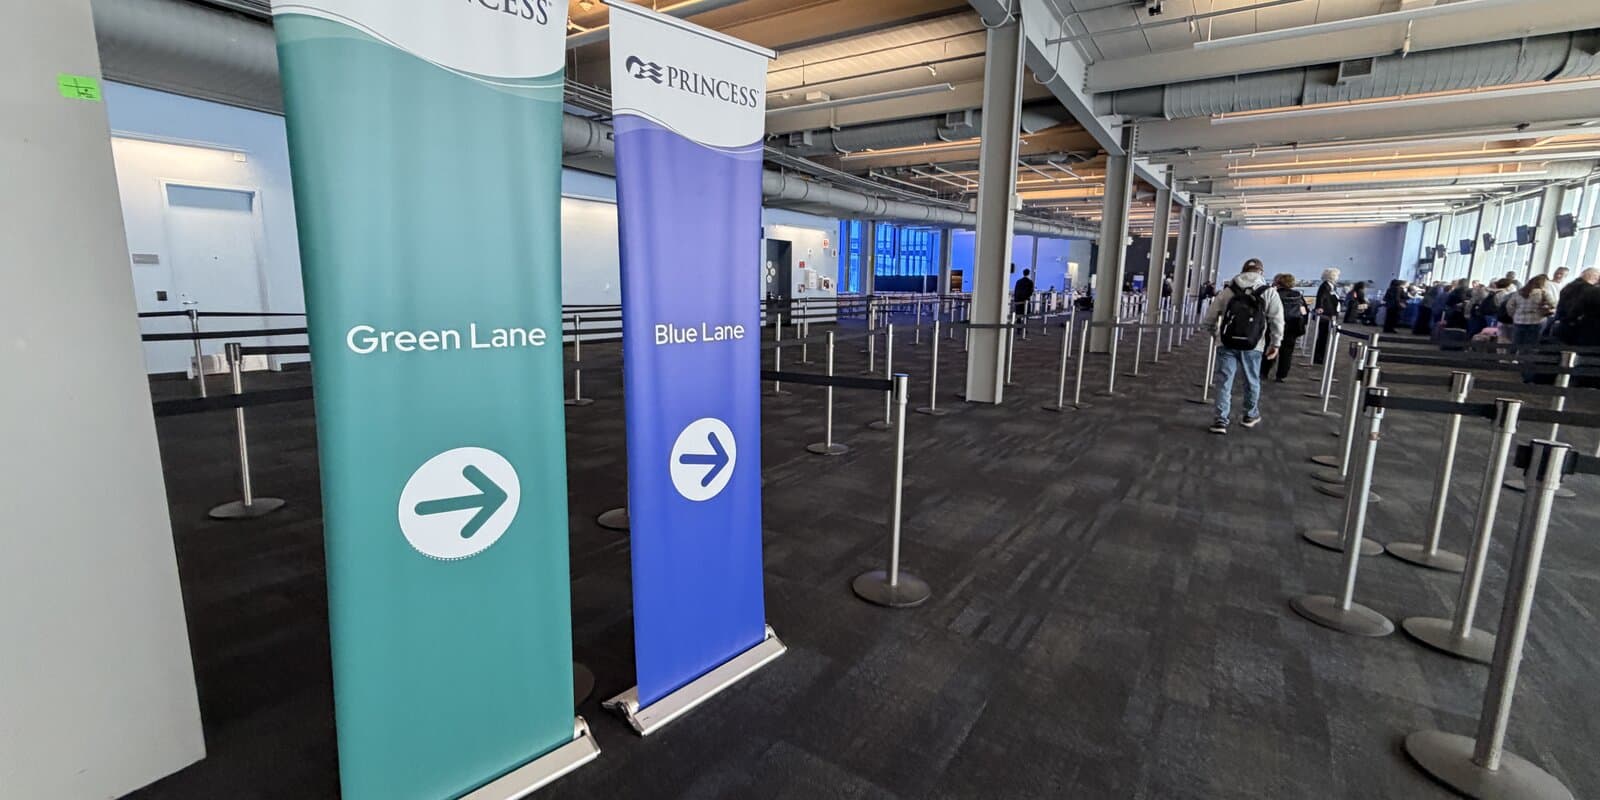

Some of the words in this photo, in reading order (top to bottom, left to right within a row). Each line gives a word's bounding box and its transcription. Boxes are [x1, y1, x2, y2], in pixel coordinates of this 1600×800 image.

[666, 66, 759, 108] PRINCESS
[346, 325, 460, 354] Green
[470, 323, 547, 349] Lane
[655, 323, 697, 345] Blue
[702, 322, 744, 341] Lane
